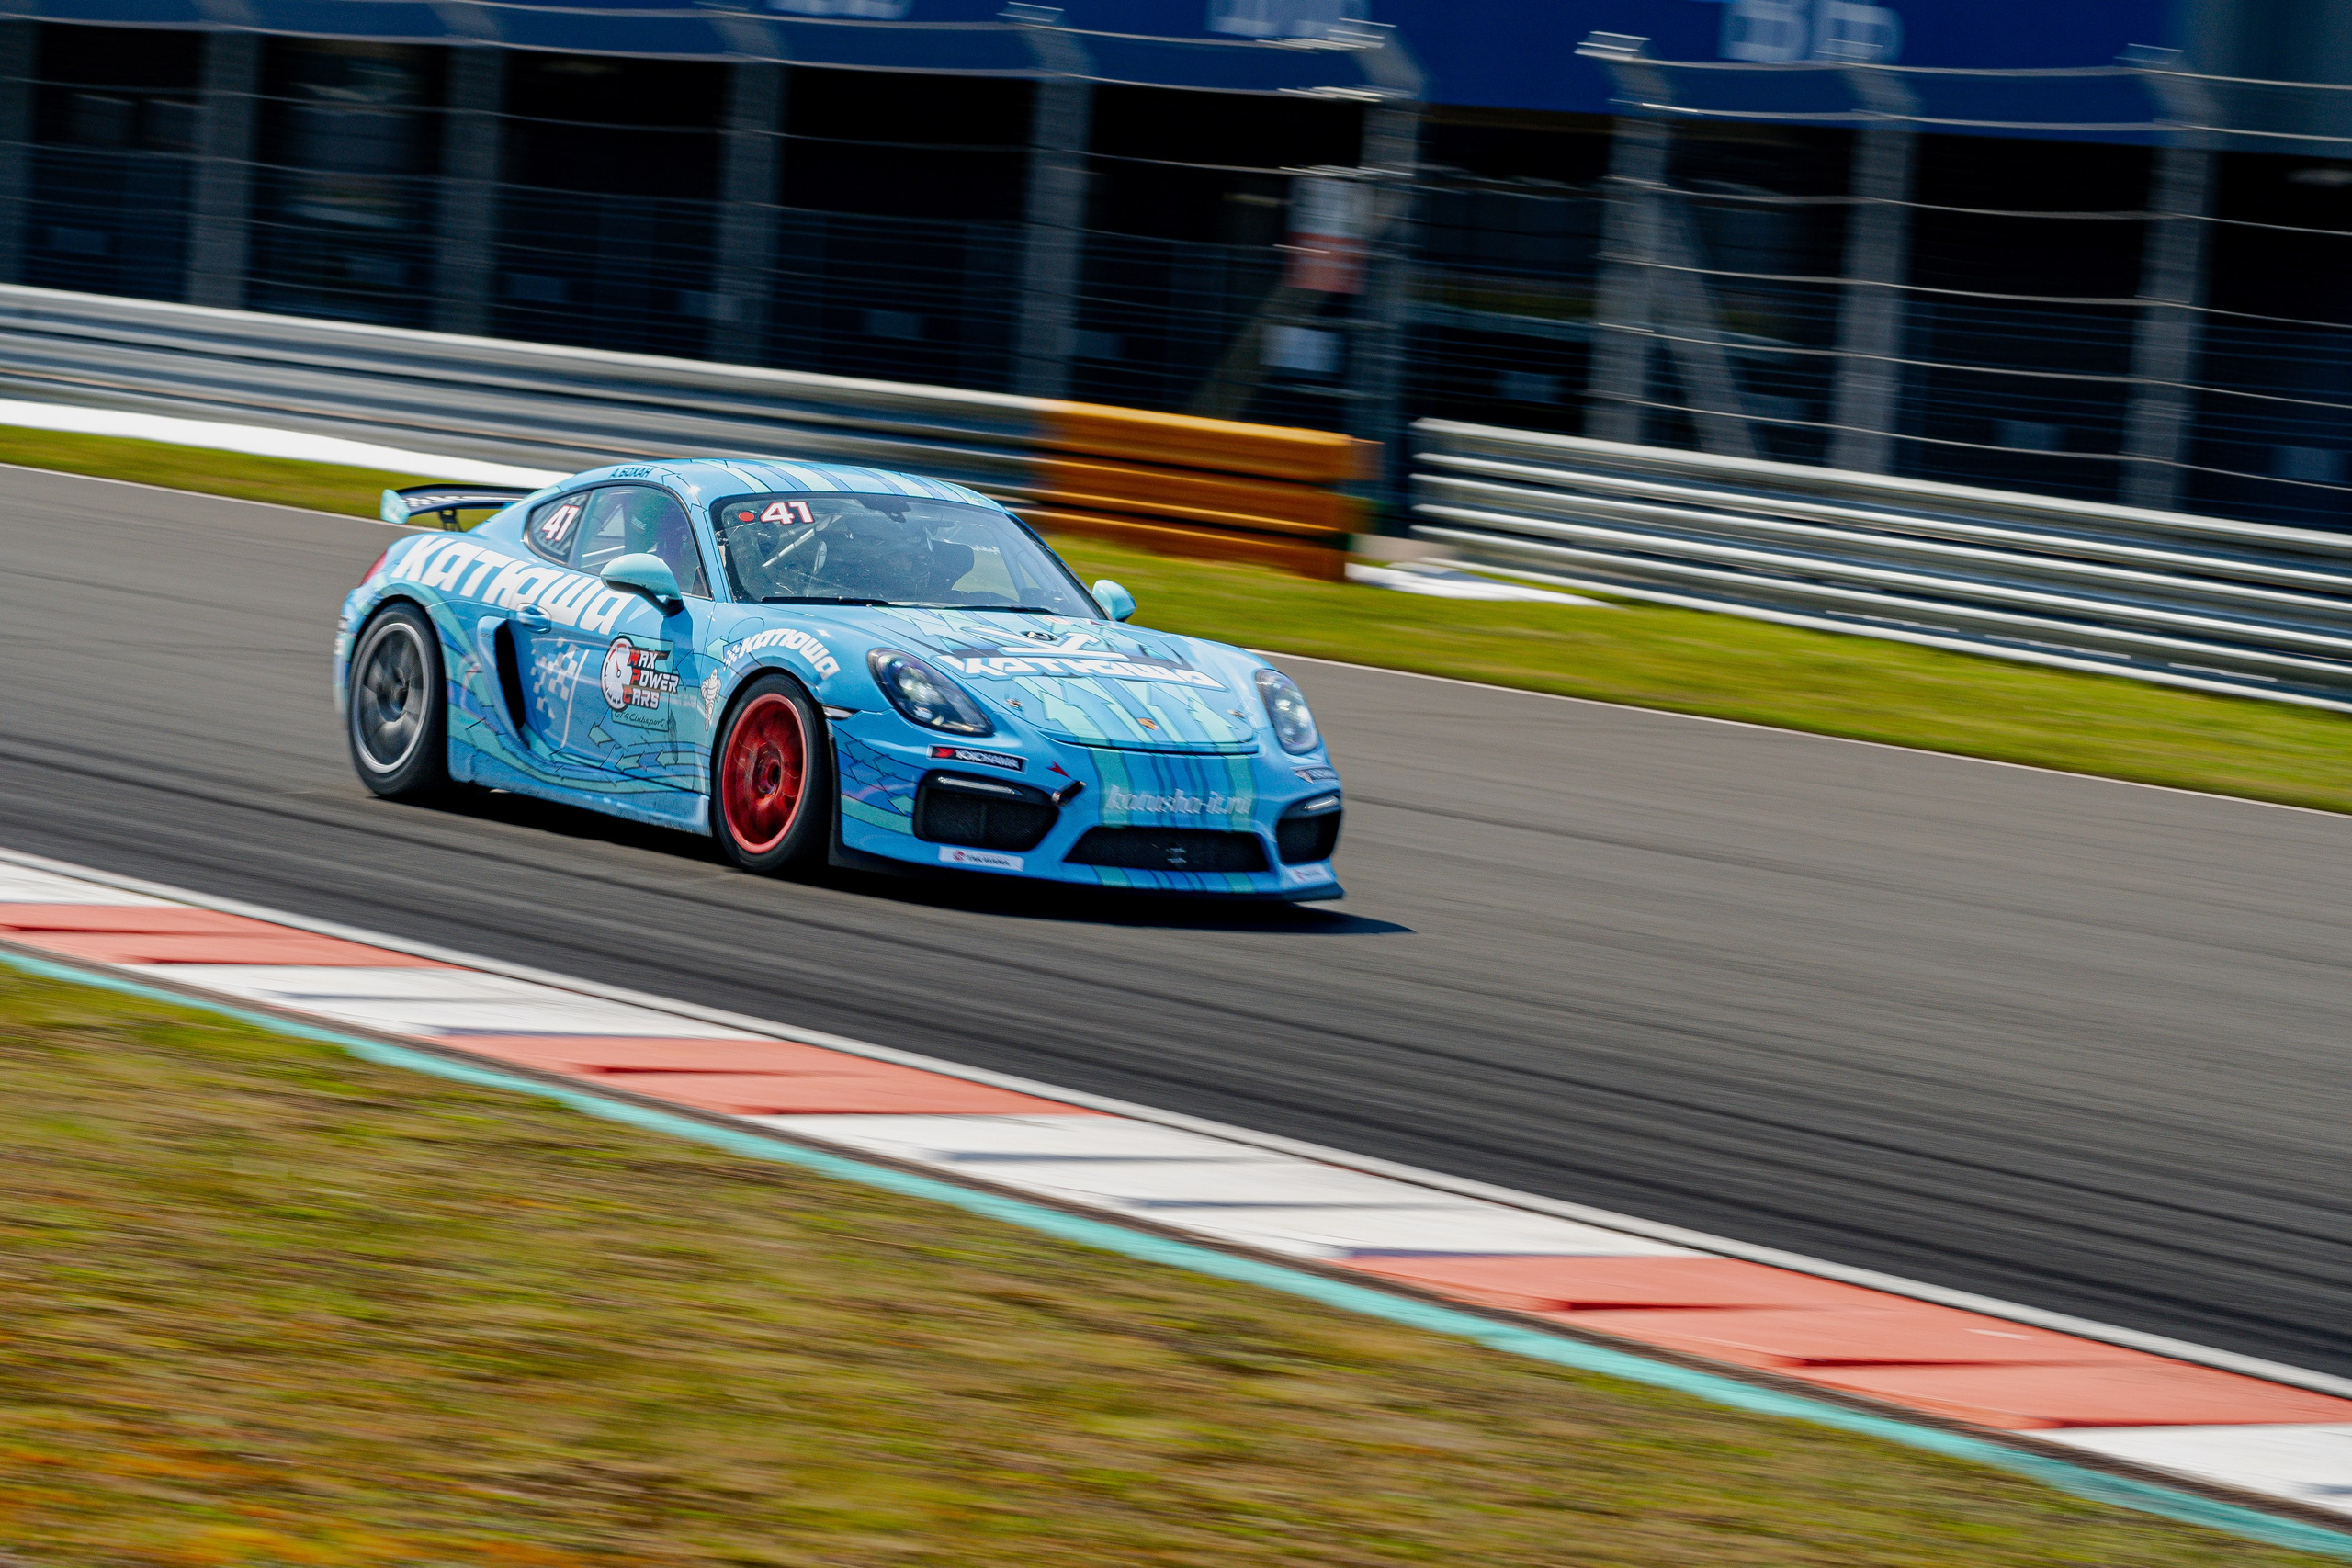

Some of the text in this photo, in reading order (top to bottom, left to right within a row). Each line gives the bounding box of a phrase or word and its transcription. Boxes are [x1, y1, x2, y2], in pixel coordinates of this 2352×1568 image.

[541, 504, 581, 542] 41
[760, 501, 815, 525] 41
[628, 649, 658, 669] MAX
[630, 668, 680, 694] POWER
[622, 686, 661, 709] CARS
